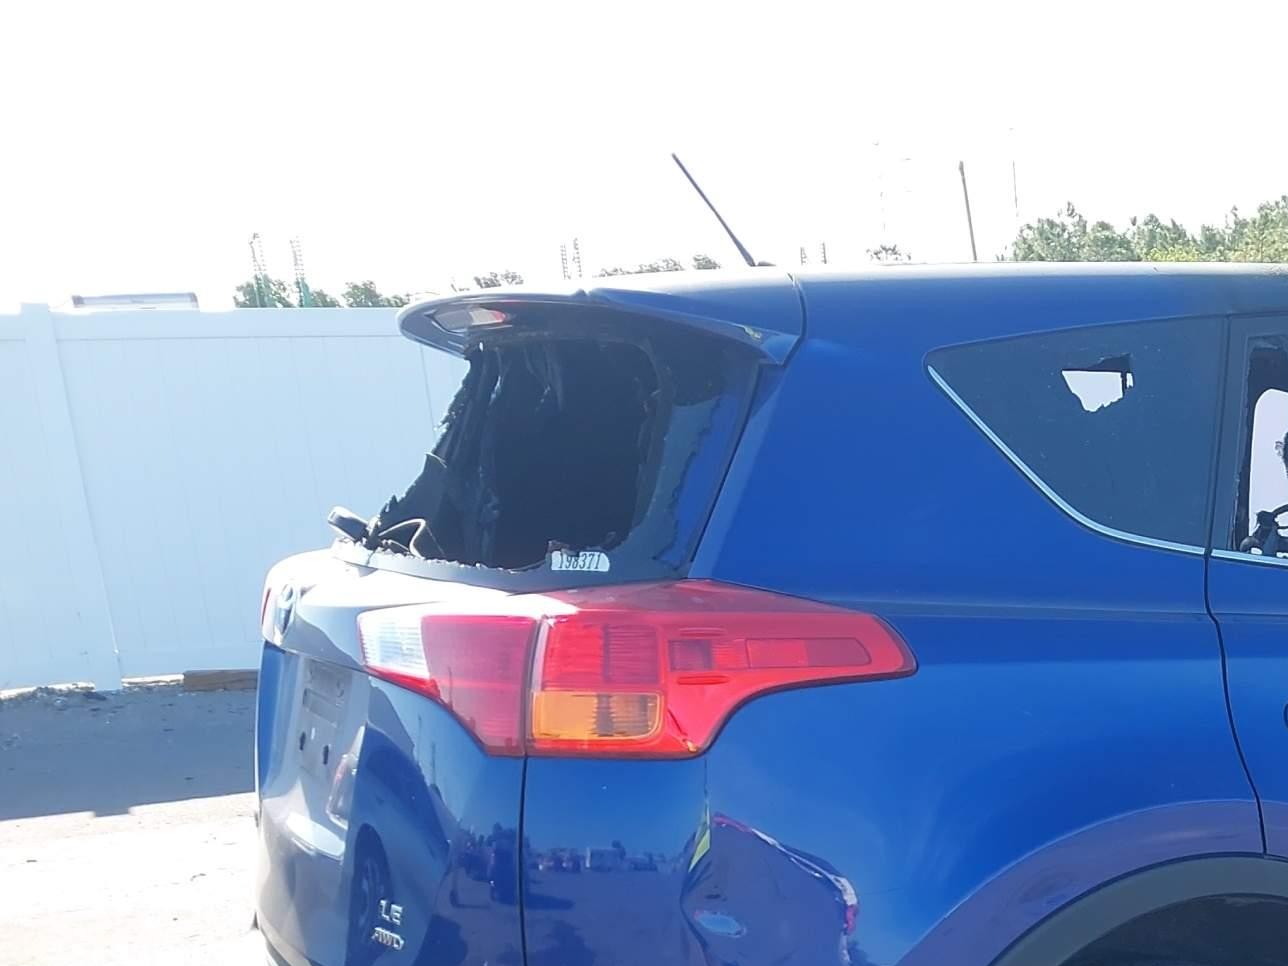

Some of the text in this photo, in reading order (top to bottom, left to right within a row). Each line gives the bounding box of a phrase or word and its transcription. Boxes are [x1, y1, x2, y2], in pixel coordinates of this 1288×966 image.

[558, 552, 600, 570] 198371
[380, 899, 403, 926] LE
[371, 927, 405, 950] AWD
